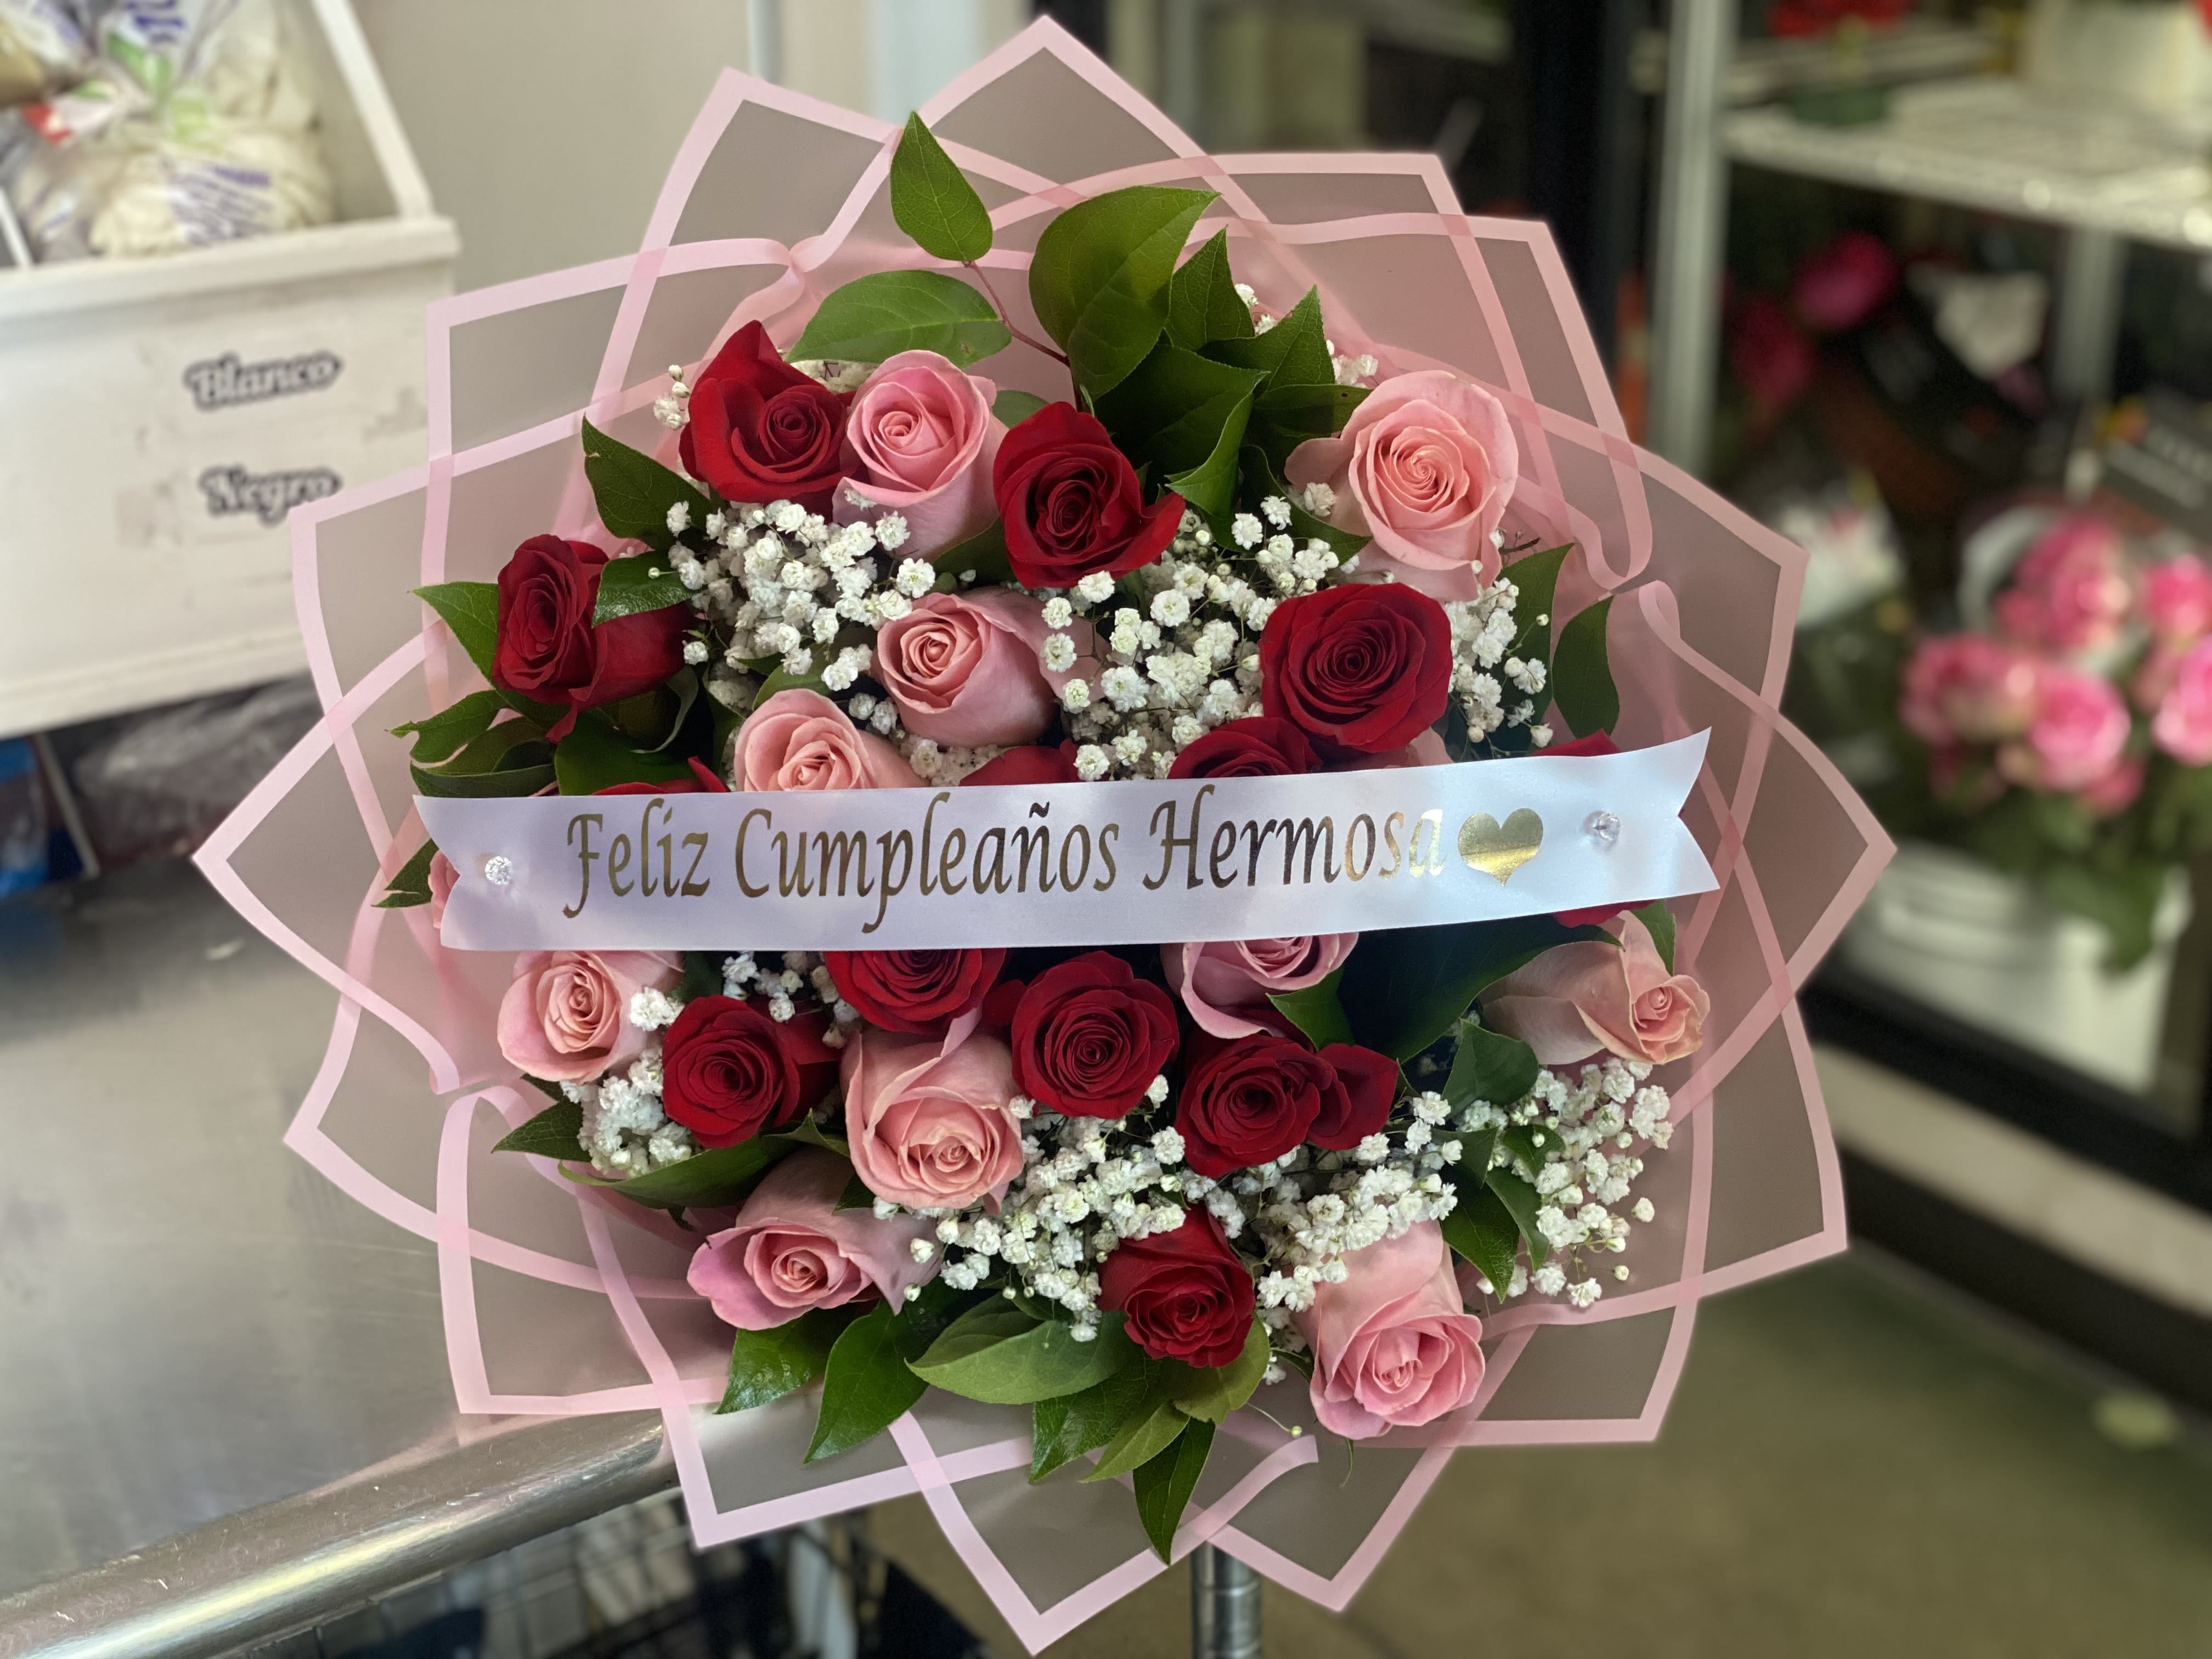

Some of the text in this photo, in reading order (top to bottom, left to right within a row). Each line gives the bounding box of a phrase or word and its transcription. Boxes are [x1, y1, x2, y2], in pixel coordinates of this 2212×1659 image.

[184, 352, 341, 410] Blanco
[199, 467, 341, 525] Negro
[562, 783, 1448, 934] Feliz Cumpleaños Hermosa
